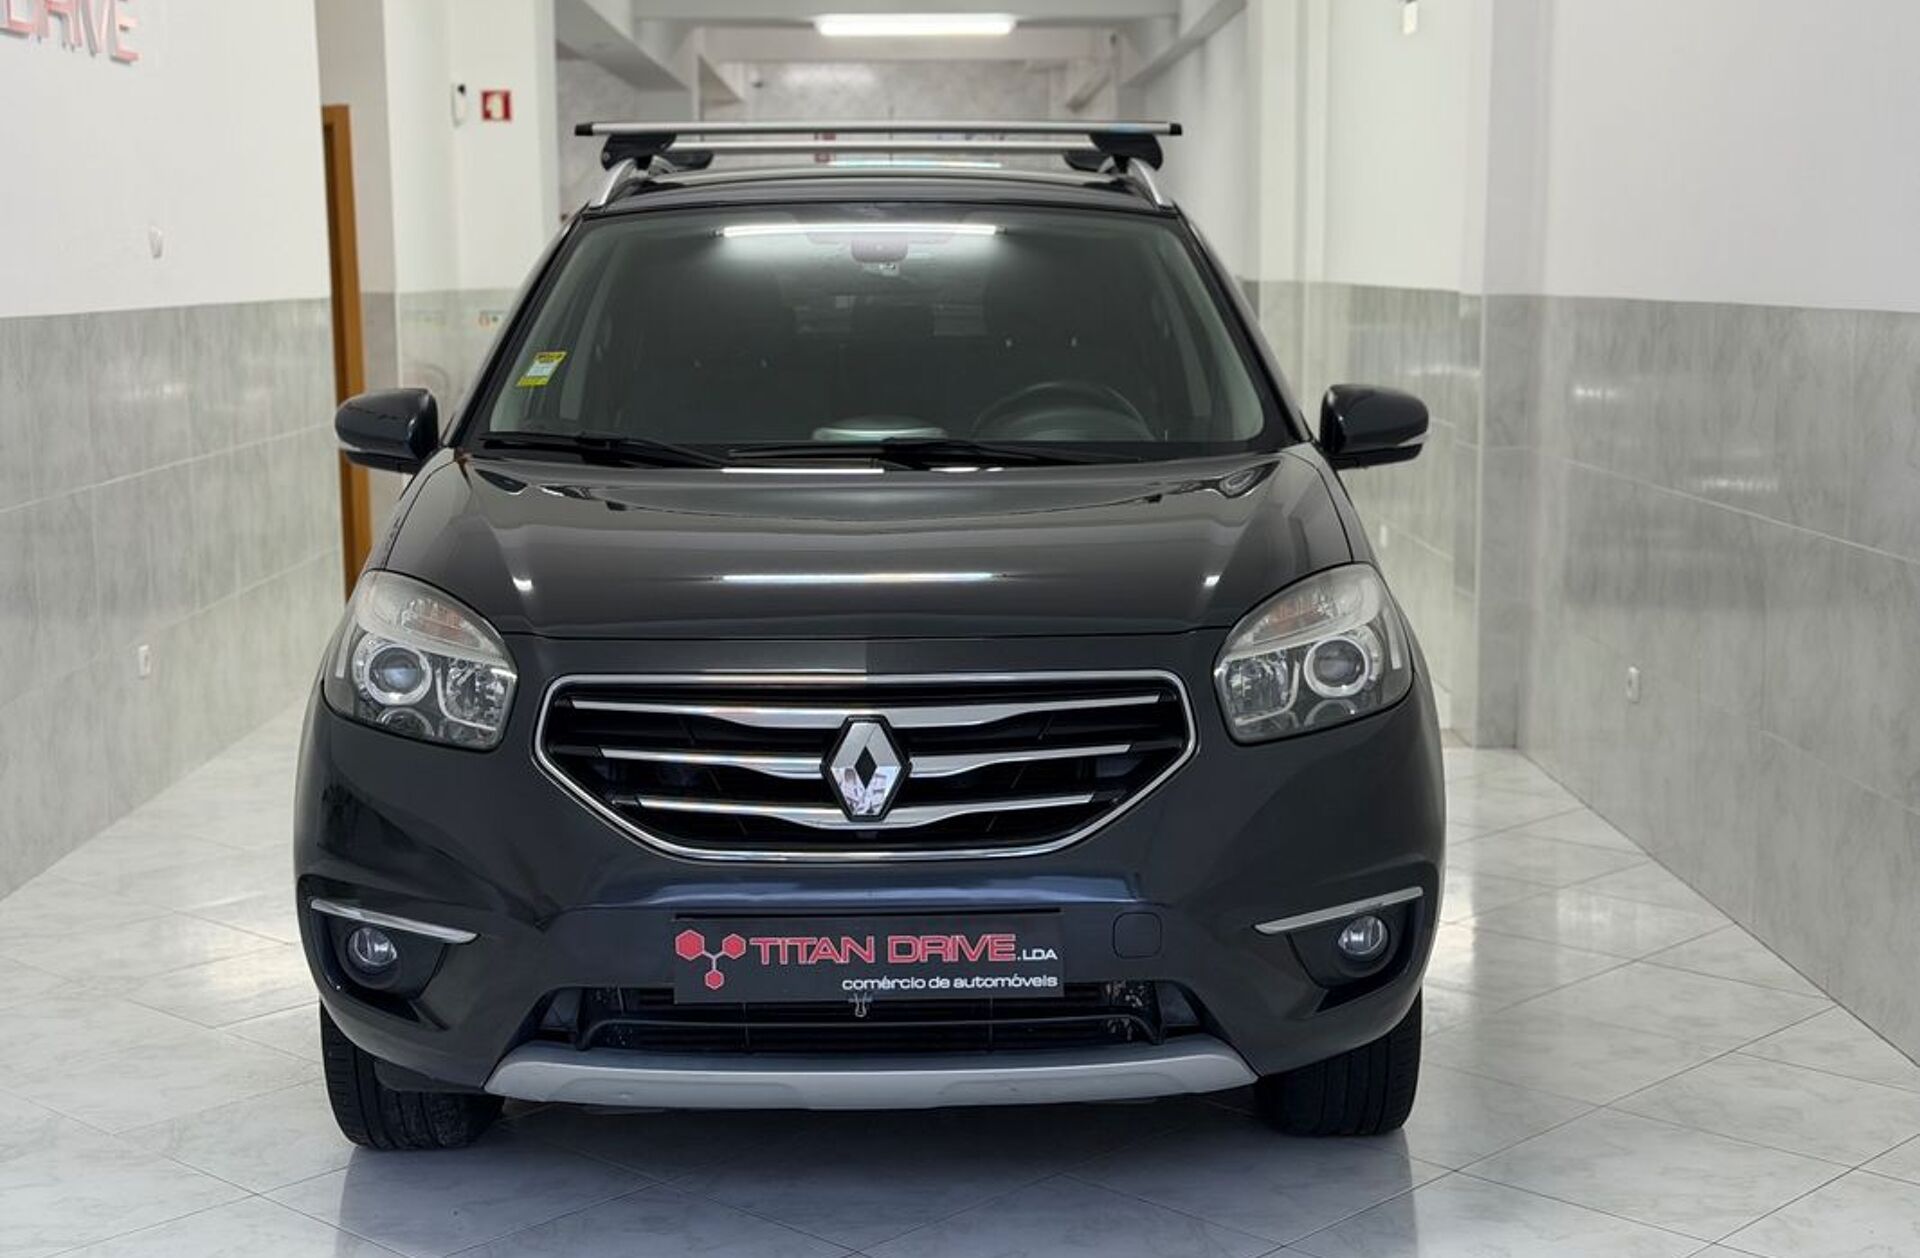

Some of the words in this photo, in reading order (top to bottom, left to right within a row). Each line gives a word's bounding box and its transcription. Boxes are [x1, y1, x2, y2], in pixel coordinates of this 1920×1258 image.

[750, 935, 875, 964] TITAN
[842, 976, 928, 991] comércio
[932, 976, 951, 990] de
[953, 973, 1058, 989] automóveis
